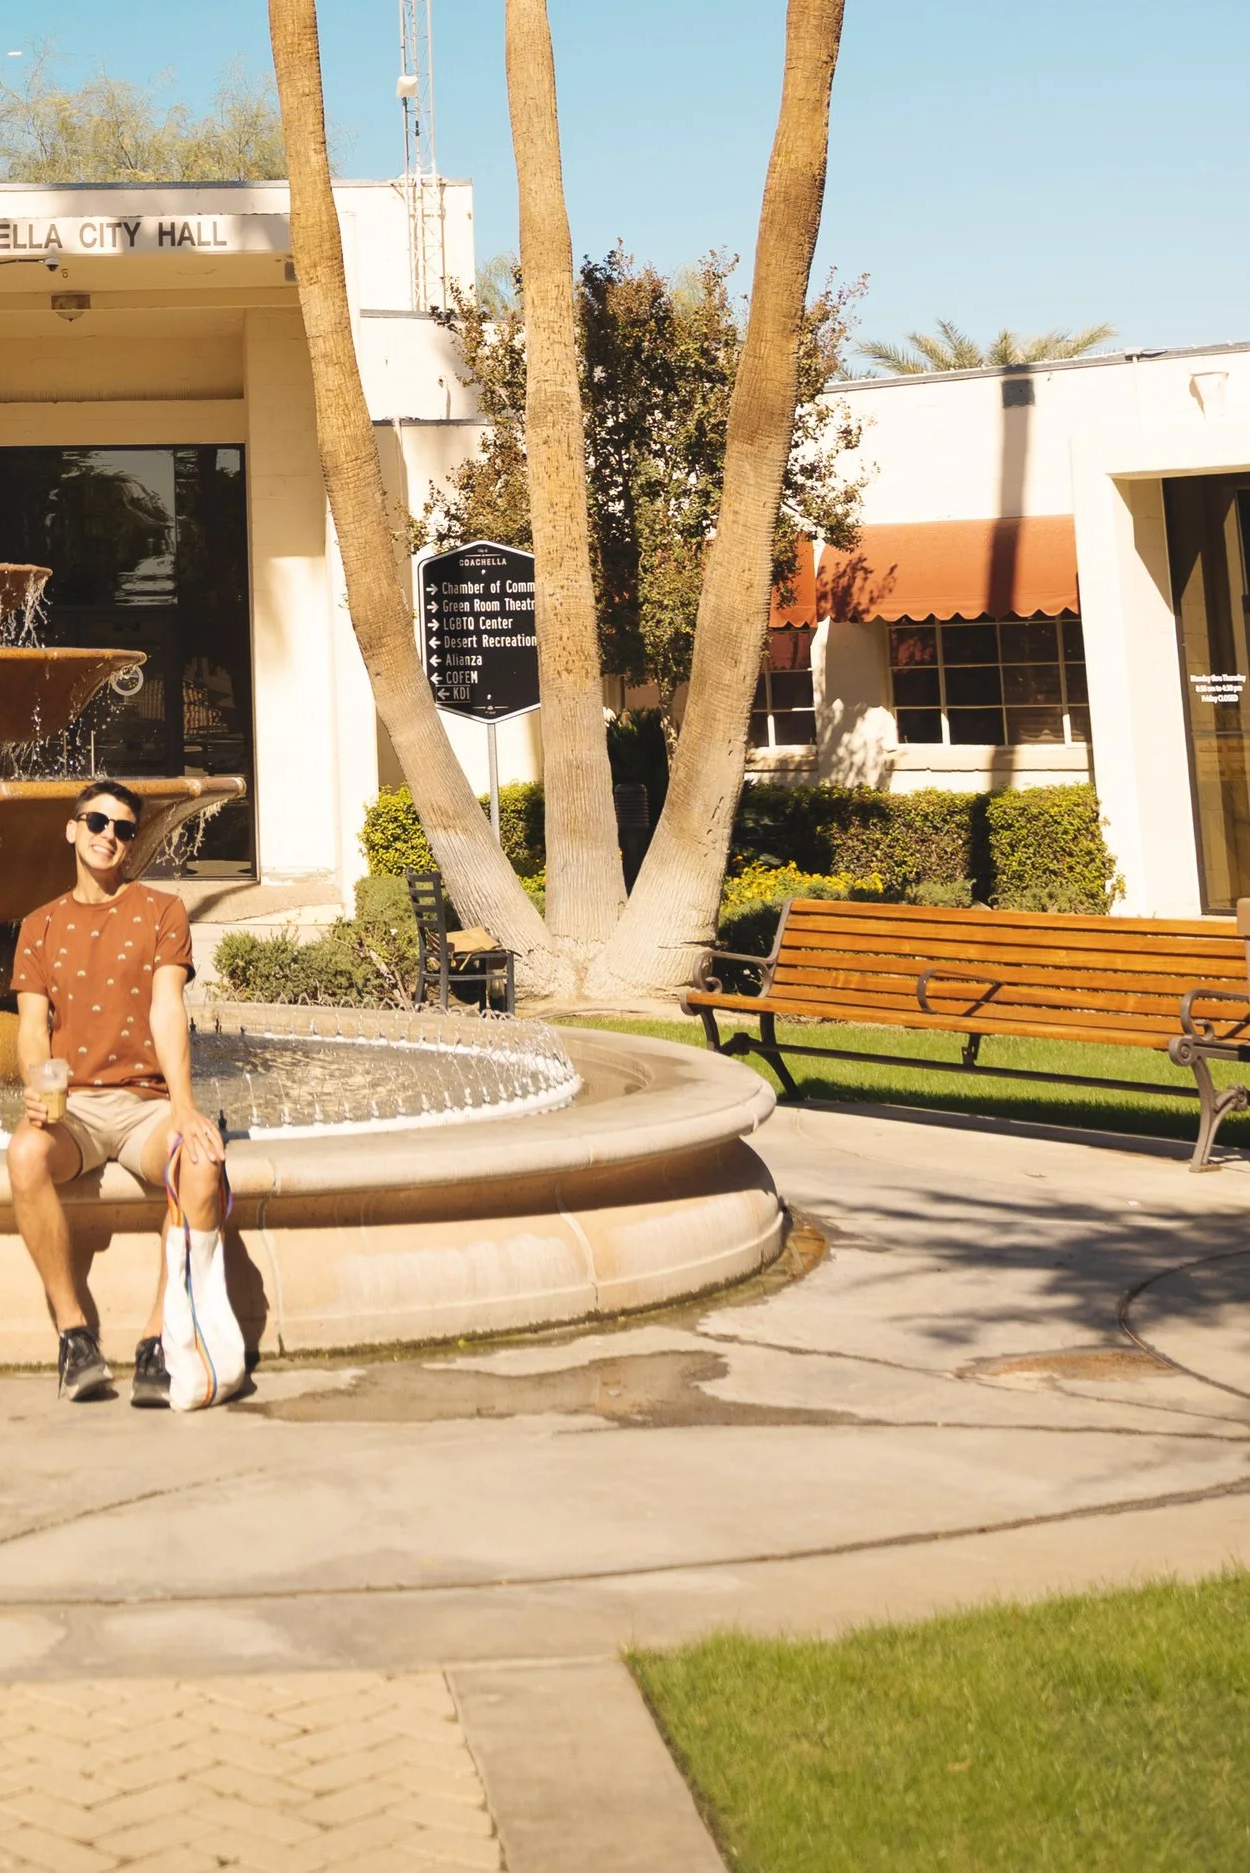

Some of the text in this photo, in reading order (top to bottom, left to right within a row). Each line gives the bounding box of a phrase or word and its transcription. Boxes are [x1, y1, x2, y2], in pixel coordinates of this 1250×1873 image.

[79, 221, 141, 248] CITY
[158, 221, 227, 247] HALL
[459, 558, 507, 566] COACHELLA
[442, 581, 484, 594] Chamber
[490, 580, 501, 594] of
[443, 599, 470, 613] Green
[474, 598, 500, 612] Room
[443, 616, 513, 631] LGBTQ Center
[444, 633, 537, 648] Desert Recreation
[445, 653, 482, 666] Alianza
[446, 670, 478, 684] COFEM
[453, 687, 470, 700] KDI
